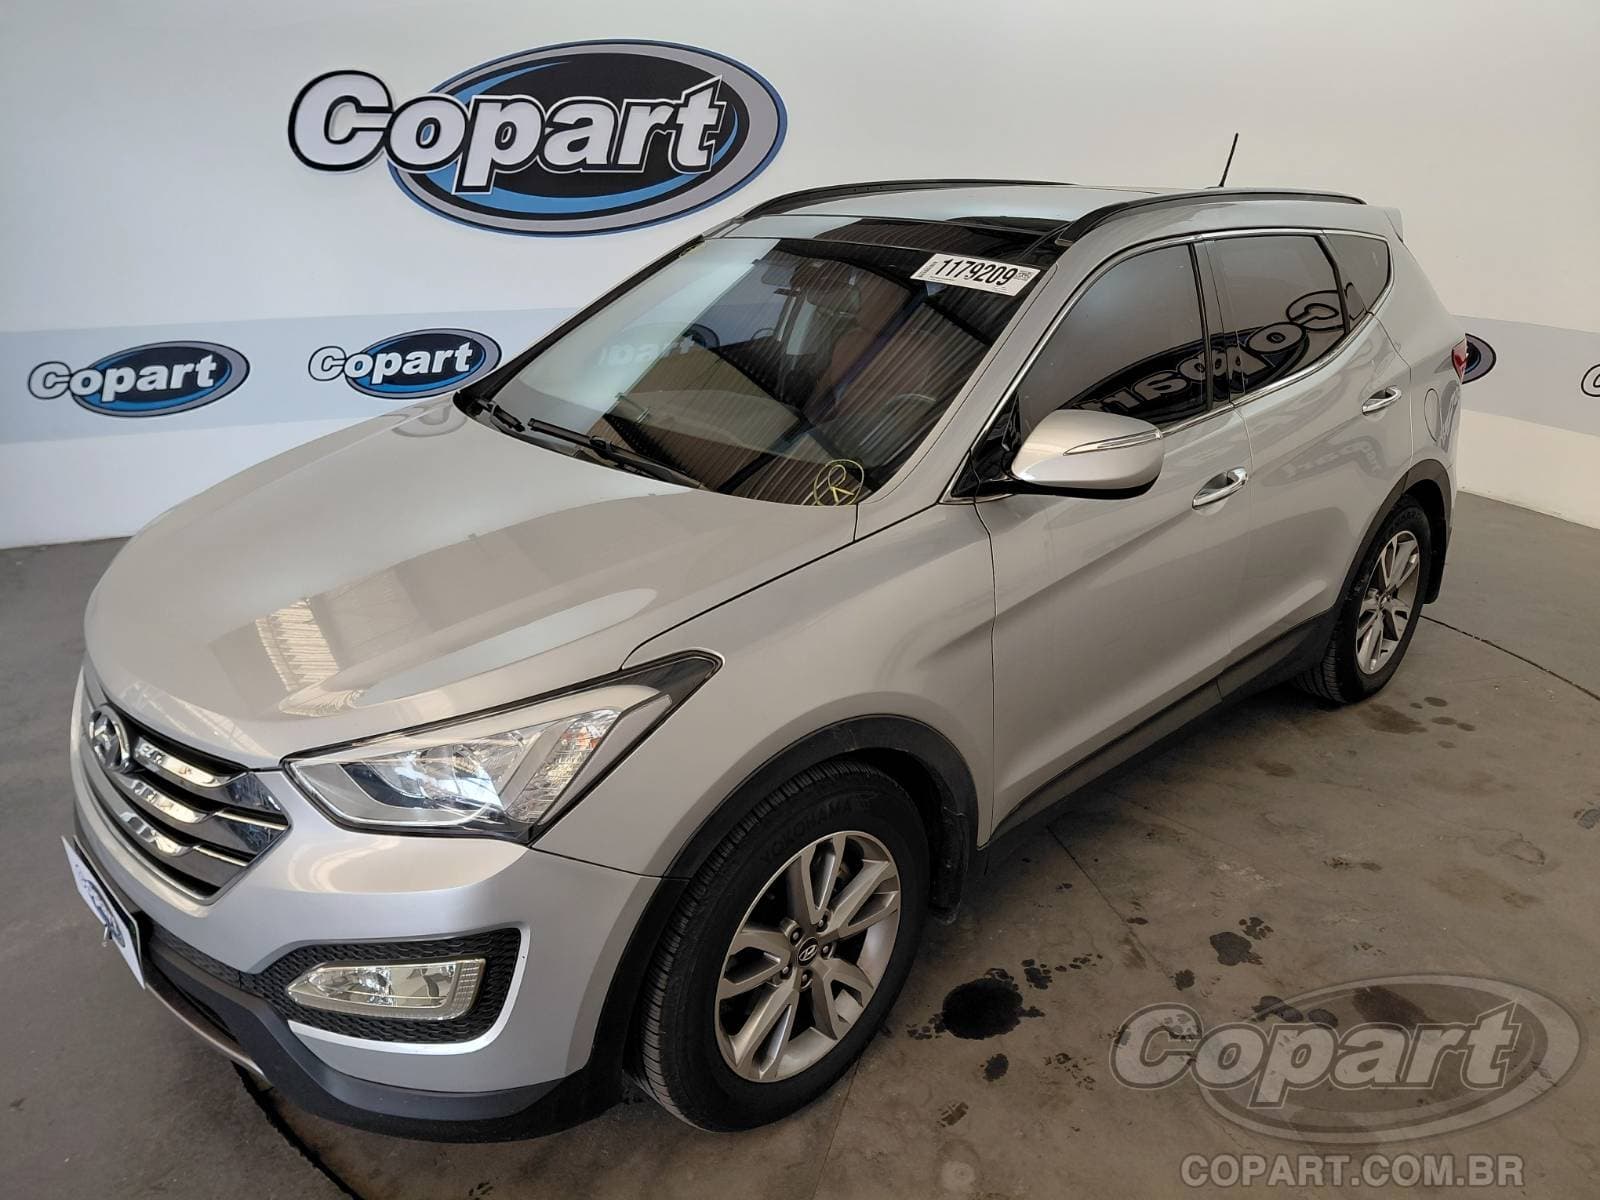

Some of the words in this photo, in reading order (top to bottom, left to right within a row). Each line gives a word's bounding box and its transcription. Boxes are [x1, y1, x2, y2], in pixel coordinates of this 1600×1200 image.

[288, 70, 727, 195] Copart
[935, 258, 1018, 286] 1179209
[28, 354, 217, 403] Copart
[308, 341, 473, 385] Copart
